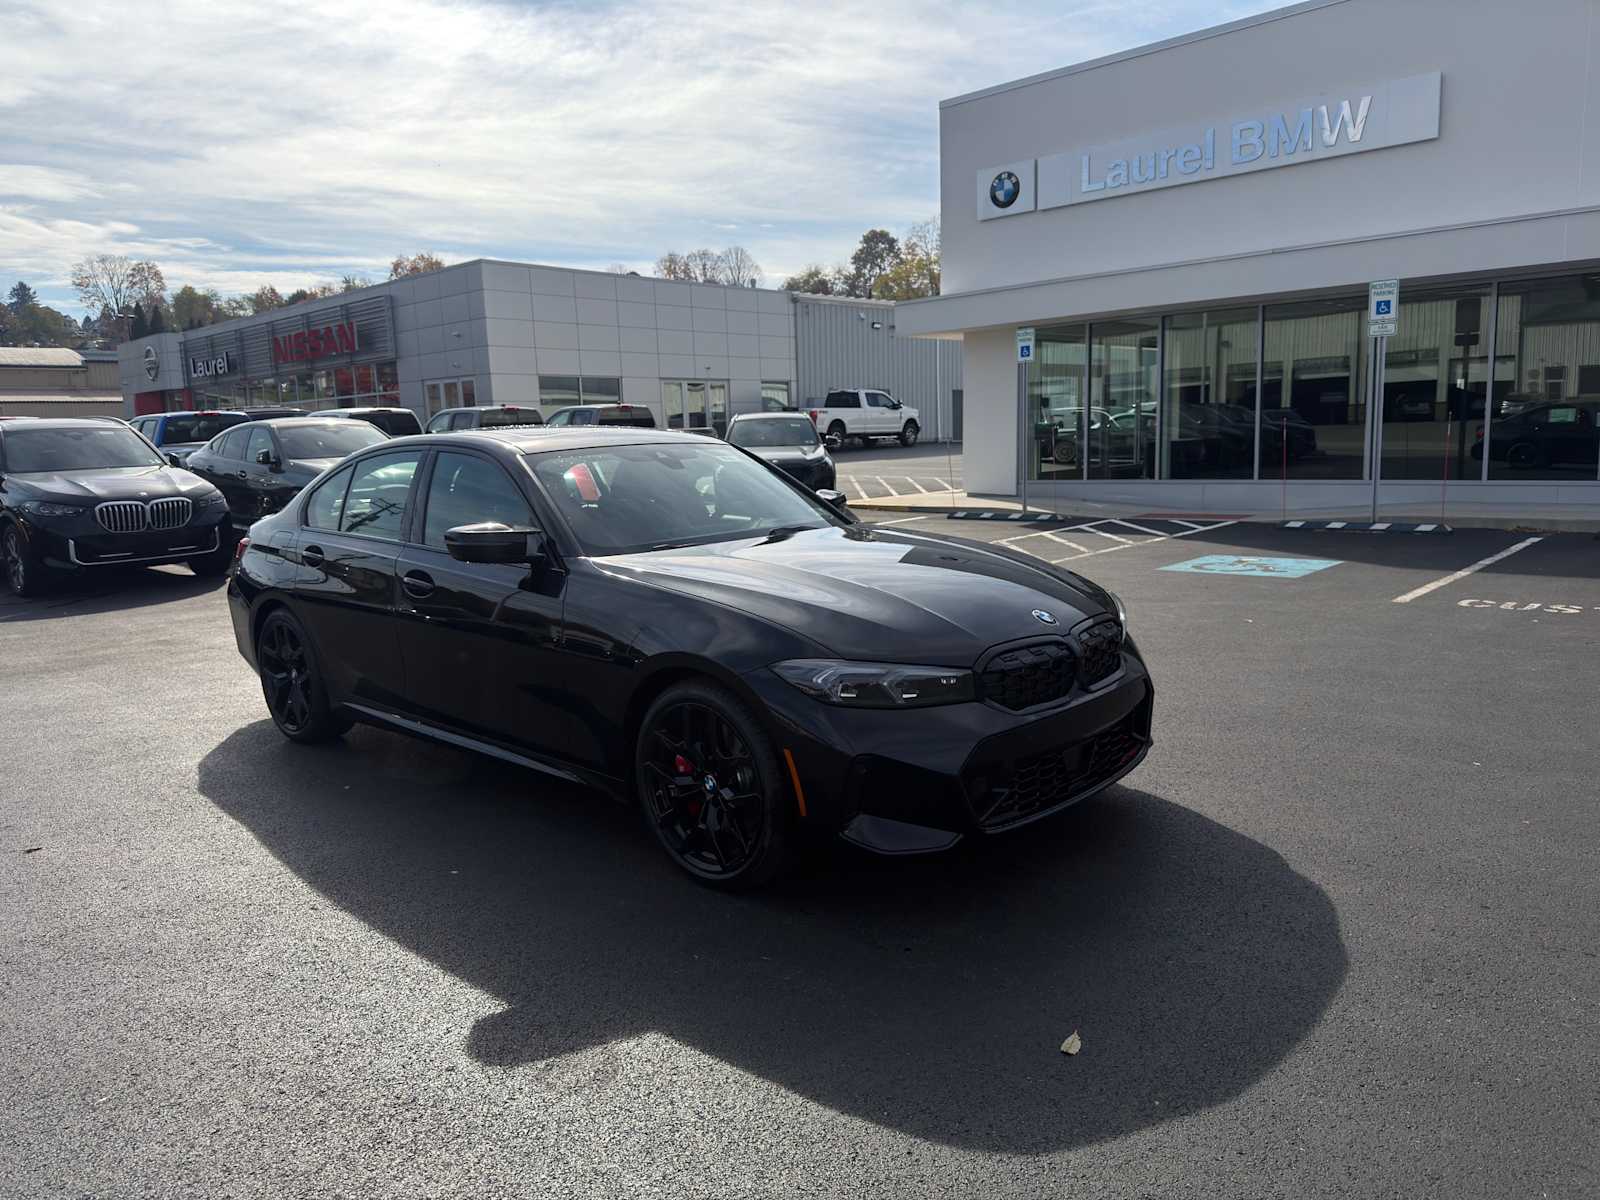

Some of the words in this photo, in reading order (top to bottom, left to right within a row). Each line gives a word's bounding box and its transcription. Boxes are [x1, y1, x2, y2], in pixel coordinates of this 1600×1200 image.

[1080, 128, 1216, 193] Laurel
[1231, 95, 1374, 165] BMW
[272, 321, 357, 363] NISSAN
[190, 351, 229, 378] Laurel
